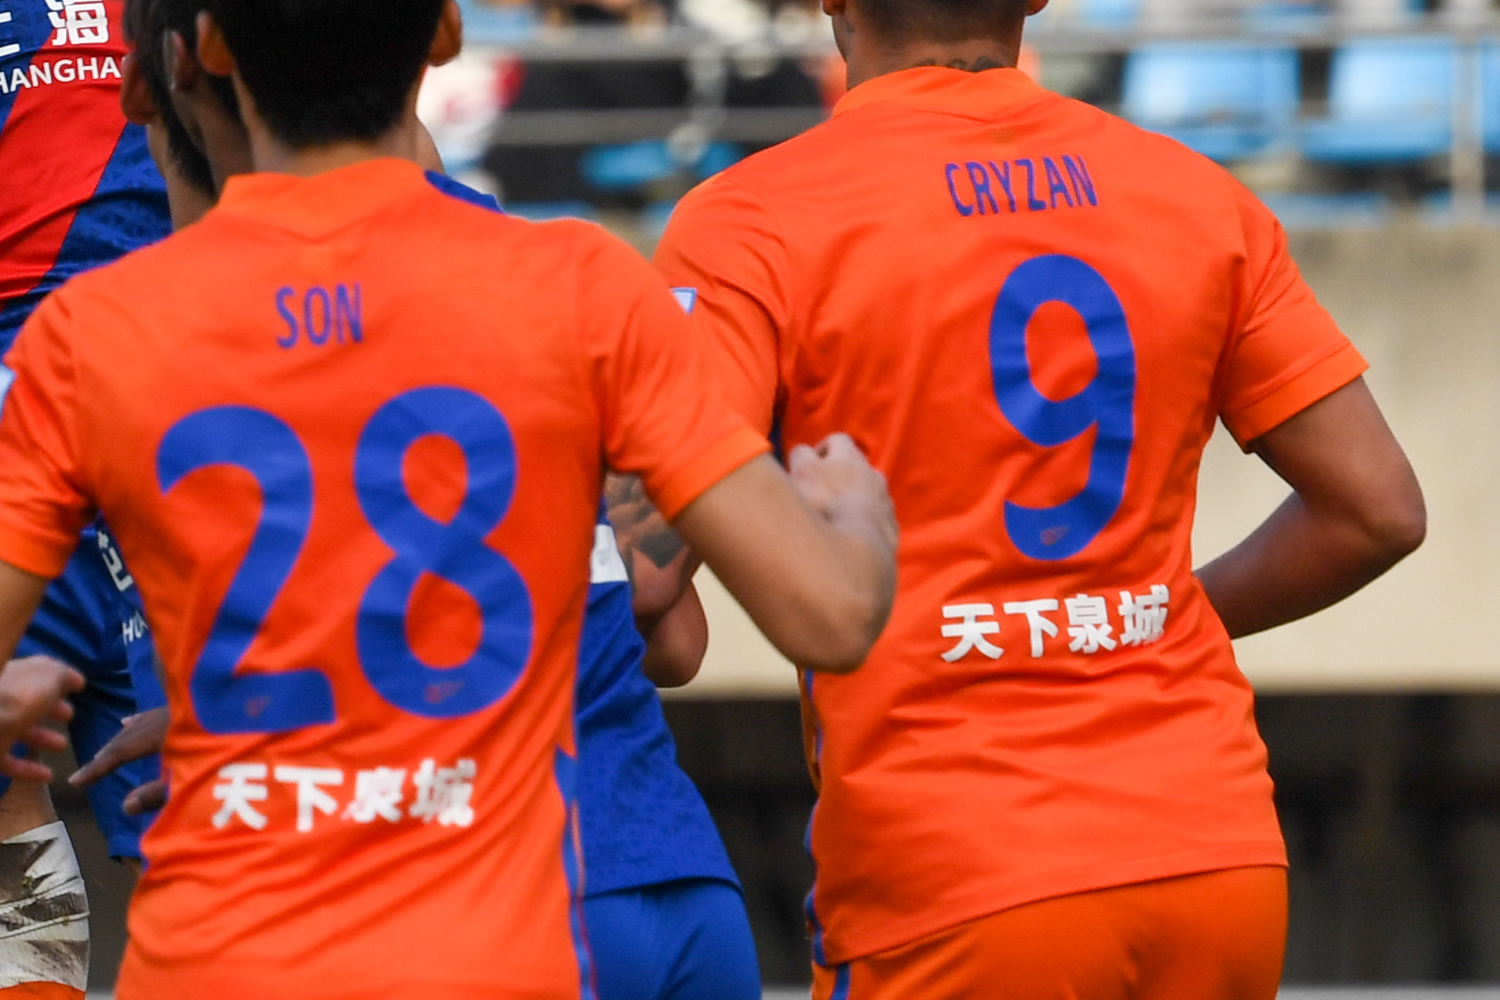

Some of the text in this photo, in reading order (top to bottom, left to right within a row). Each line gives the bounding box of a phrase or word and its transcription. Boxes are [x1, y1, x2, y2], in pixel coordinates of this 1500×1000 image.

[945, 155, 1098, 216] CRYZAN
[275, 284, 363, 349] SON
[989, 253, 1136, 561] 9
[155, 385, 534, 735] 28
[940, 584, 1170, 662] 天下泉城
[212, 758, 477, 833] 天下泉城
